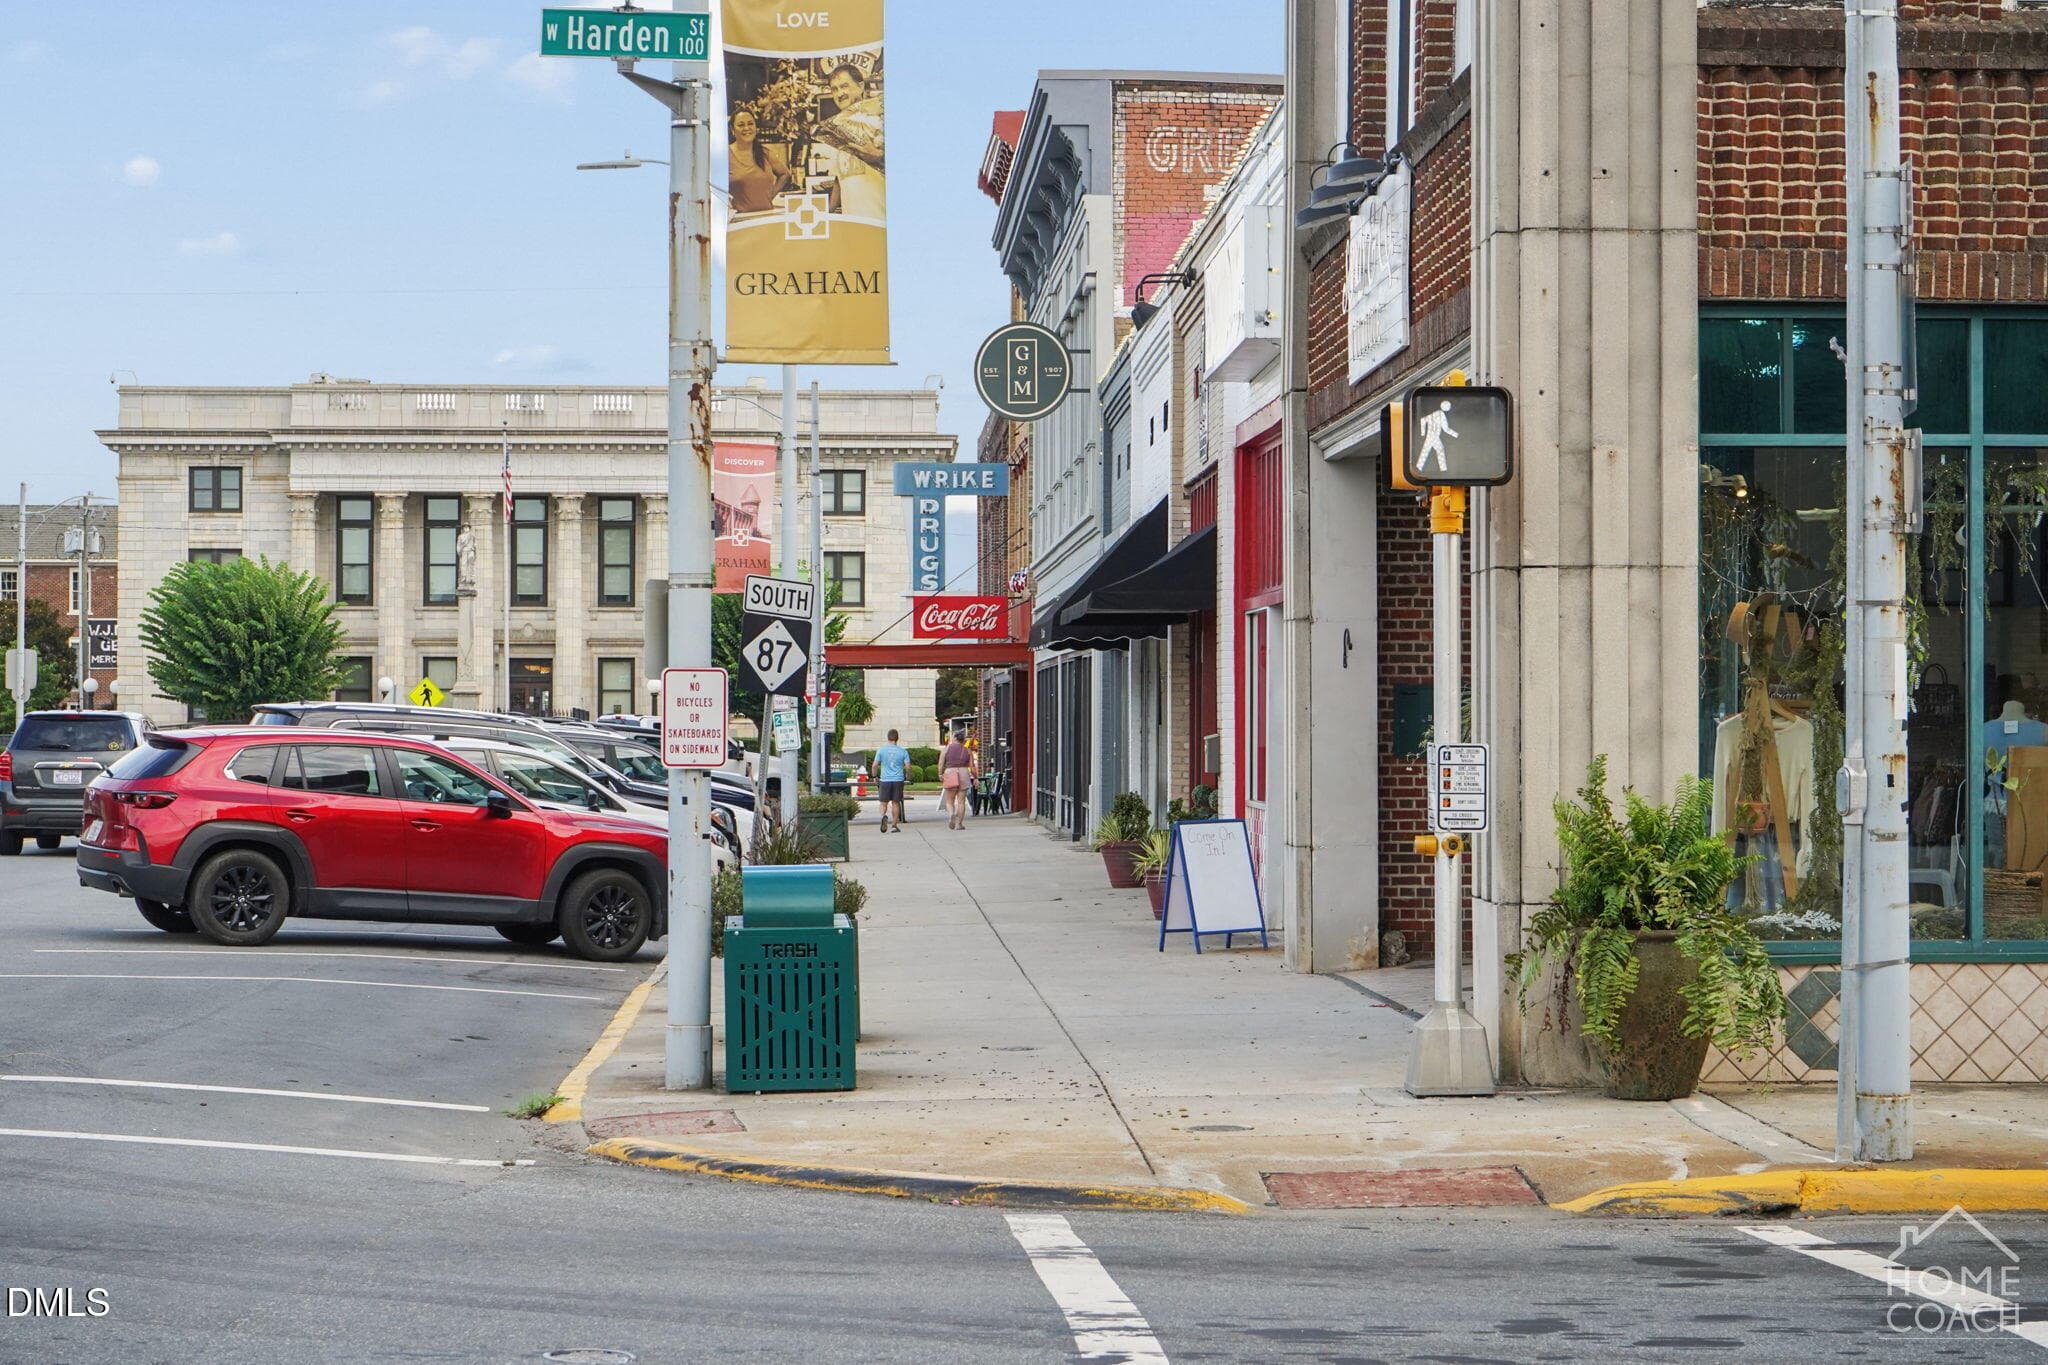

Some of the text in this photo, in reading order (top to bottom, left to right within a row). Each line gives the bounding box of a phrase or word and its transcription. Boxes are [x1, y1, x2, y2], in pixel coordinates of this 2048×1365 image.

[776, 12, 829, 28] LOVE
[547, 16, 704, 53] W Harden St
[679, 37, 704, 55] 100
[734, 270, 880, 296] GRAHAM
[1015, 345, 1029, 361] G
[1013, 380, 1032, 396] M
[724, 457, 765, 467] DISCOVER
[913, 470, 995, 489] WRIKE
[920, 498, 940, 591] DRUGS
[715, 557, 767, 569] GRAHAM
[750, 583, 809, 611] SOUTH
[757, 637, 793, 674] 87
[689, 682, 700, 692] NO
[676, 697, 713, 708] BICYCLES
[689, 713, 700, 723] OR
[774, 714, 782, 727] 2
[668, 728, 721, 739] SKATEBOARDS
[669, 744, 719, 754] ON SIDEWALK
[1187, 826, 1236, 843] Come On
[761, 943, 818, 958] TRASH
